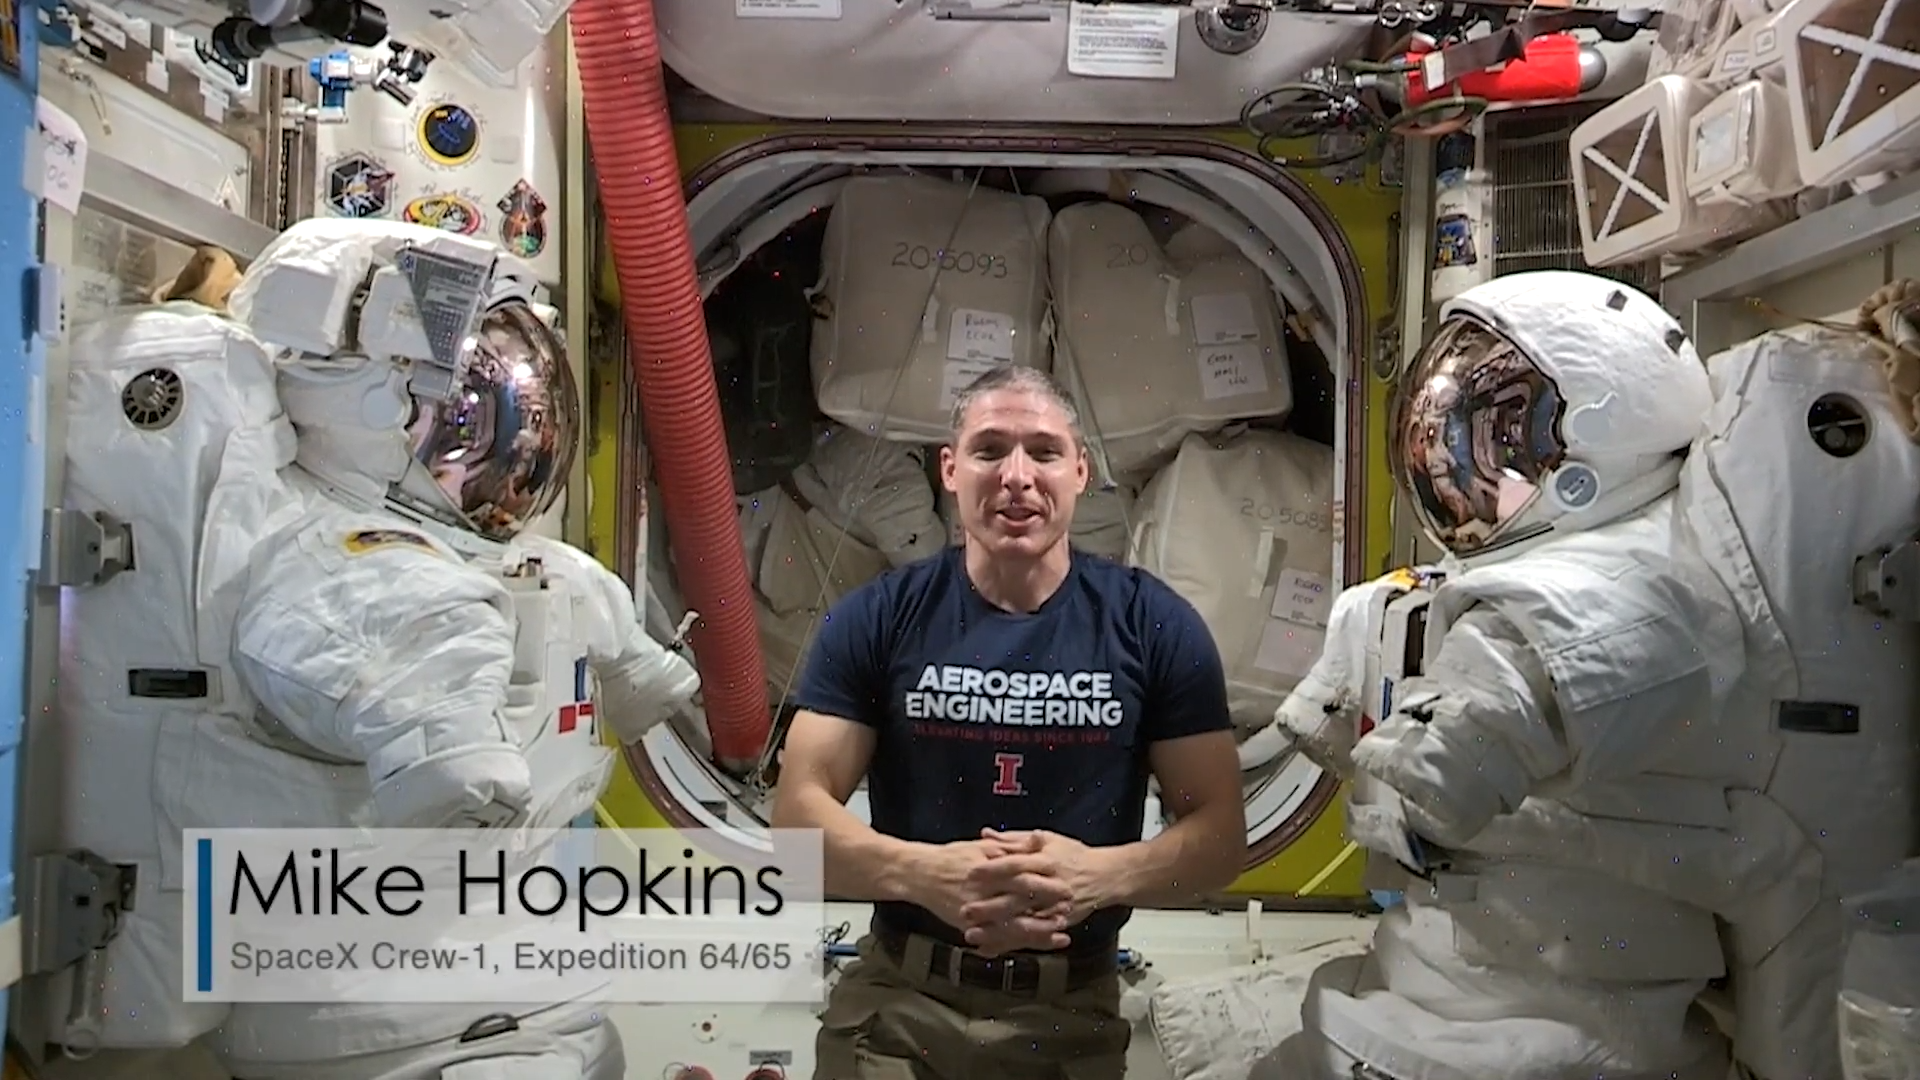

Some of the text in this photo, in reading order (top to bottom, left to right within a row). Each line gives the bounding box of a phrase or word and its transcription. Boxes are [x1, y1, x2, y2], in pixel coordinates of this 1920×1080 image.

[917, 665, 1113, 699] AEROSPACE
[905, 691, 1124, 727] ENGINEERING
[994, 753, 1024, 795] I
